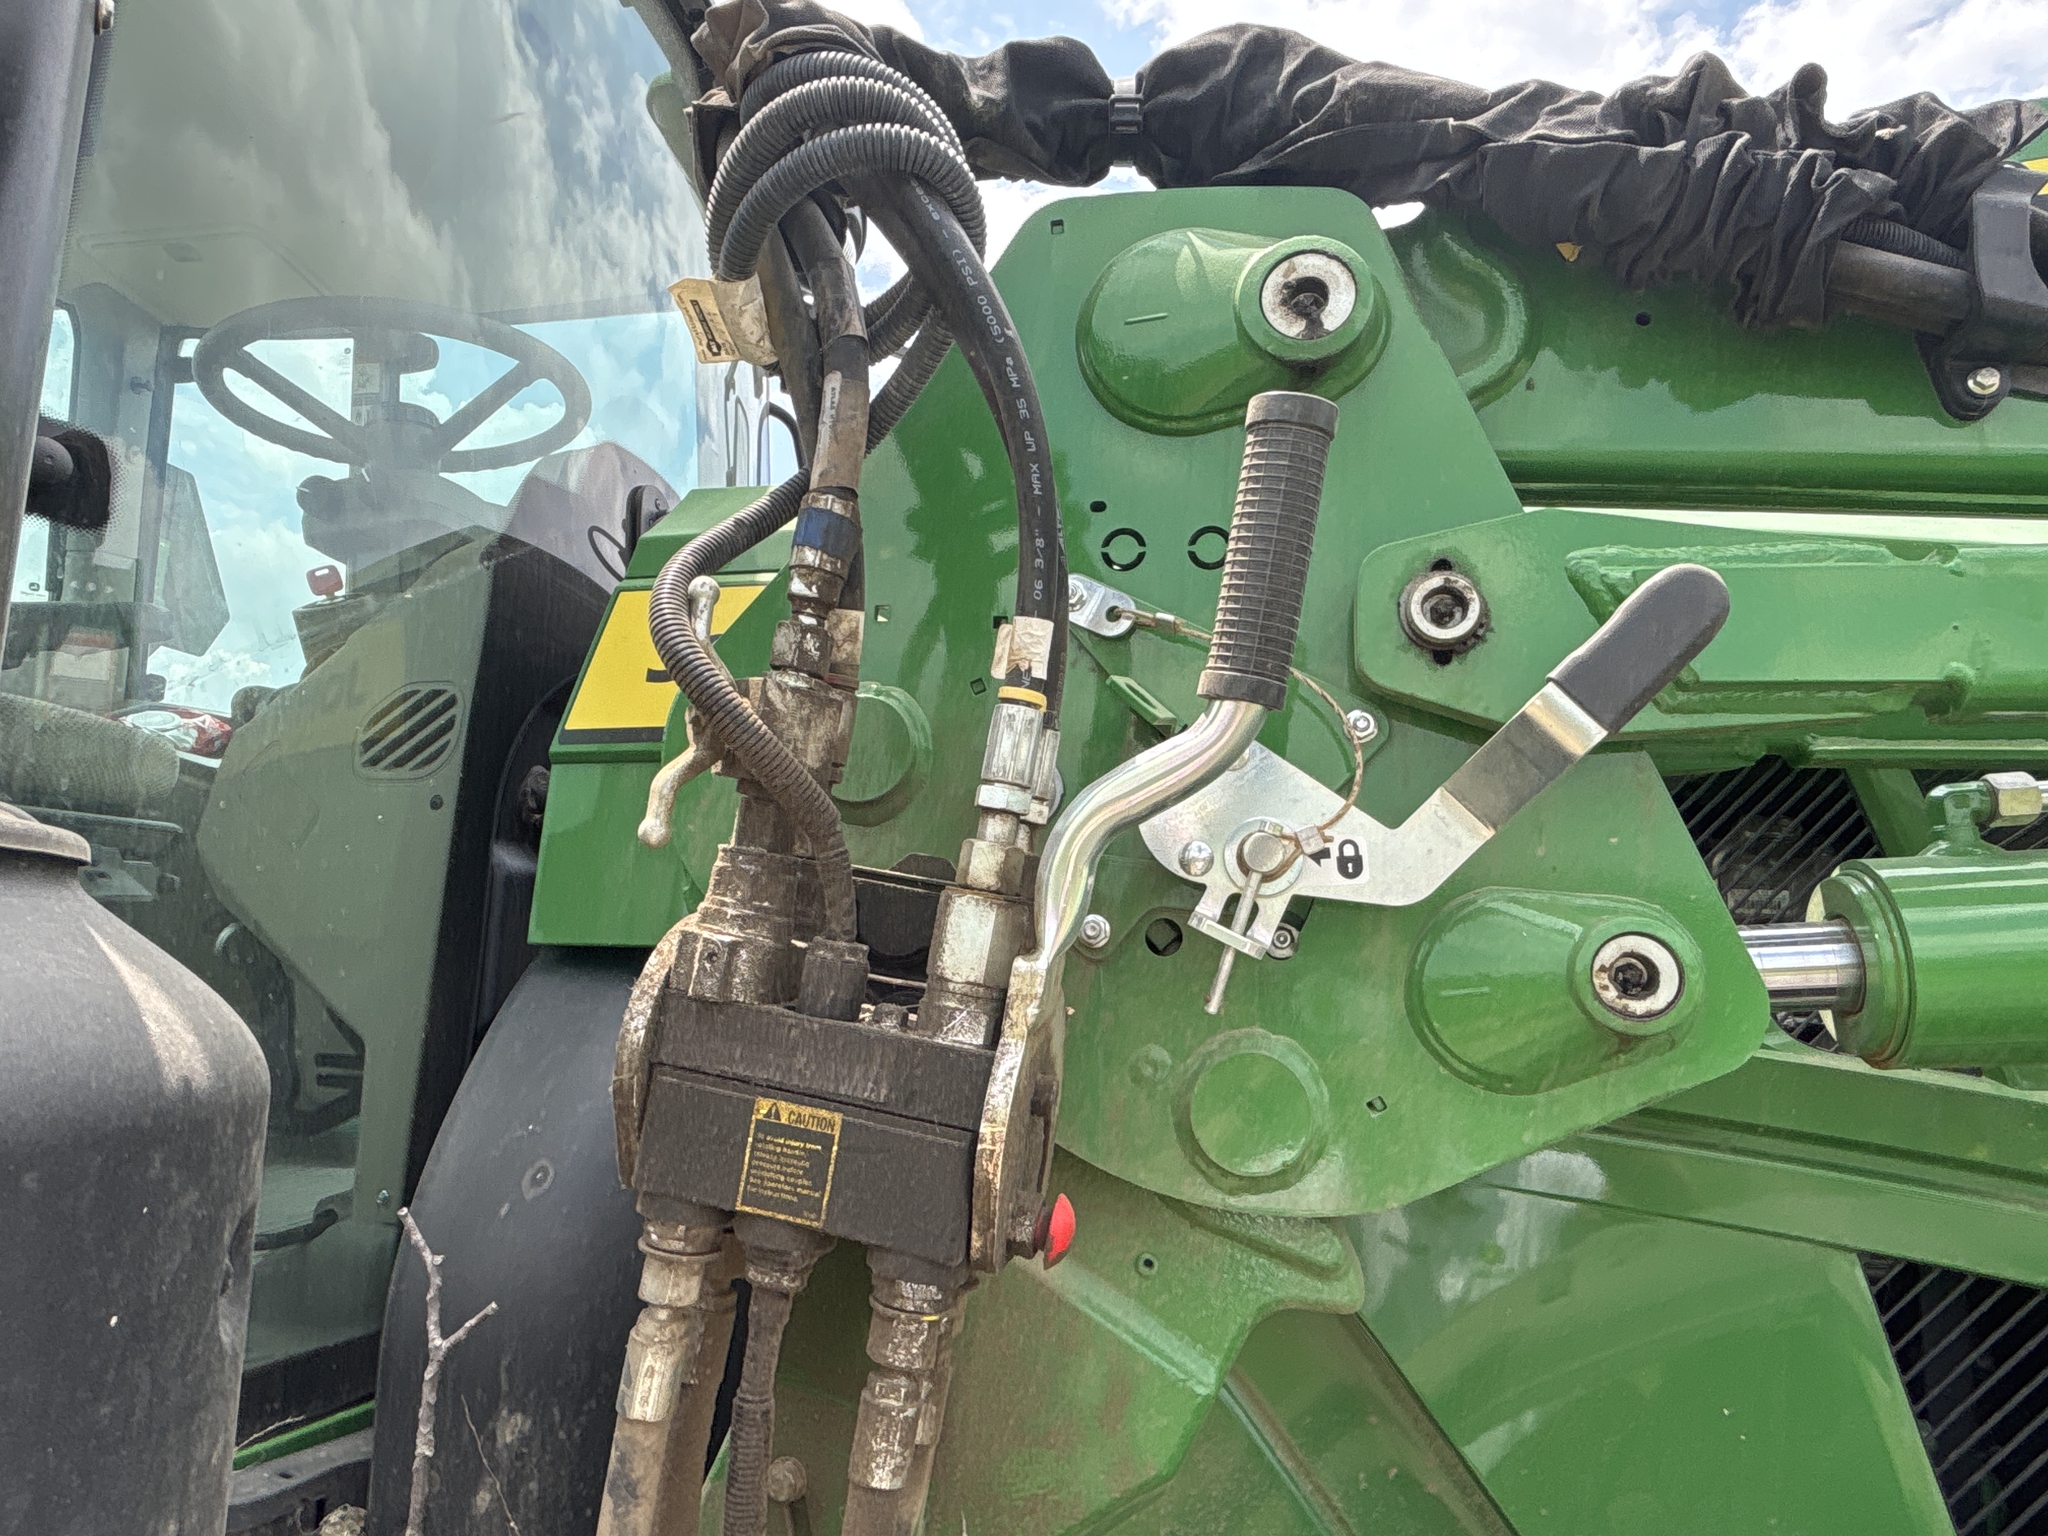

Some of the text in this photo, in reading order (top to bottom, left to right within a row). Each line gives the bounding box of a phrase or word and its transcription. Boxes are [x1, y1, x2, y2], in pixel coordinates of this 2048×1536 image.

[952, 249, 979, 287] PSI)
[977, 295, 1005, 344] (5000
[1005, 356, 1020, 388] MPa
[1016, 398, 1030, 420] 35
[1024, 431, 1036, 452] WP
[1029, 462, 1042, 495] MAX
[1034, 529, 1045, 569] 3/8"
[1033, 579, 1043, 600] 06
[787, 1110, 836, 1133] CAUTION
